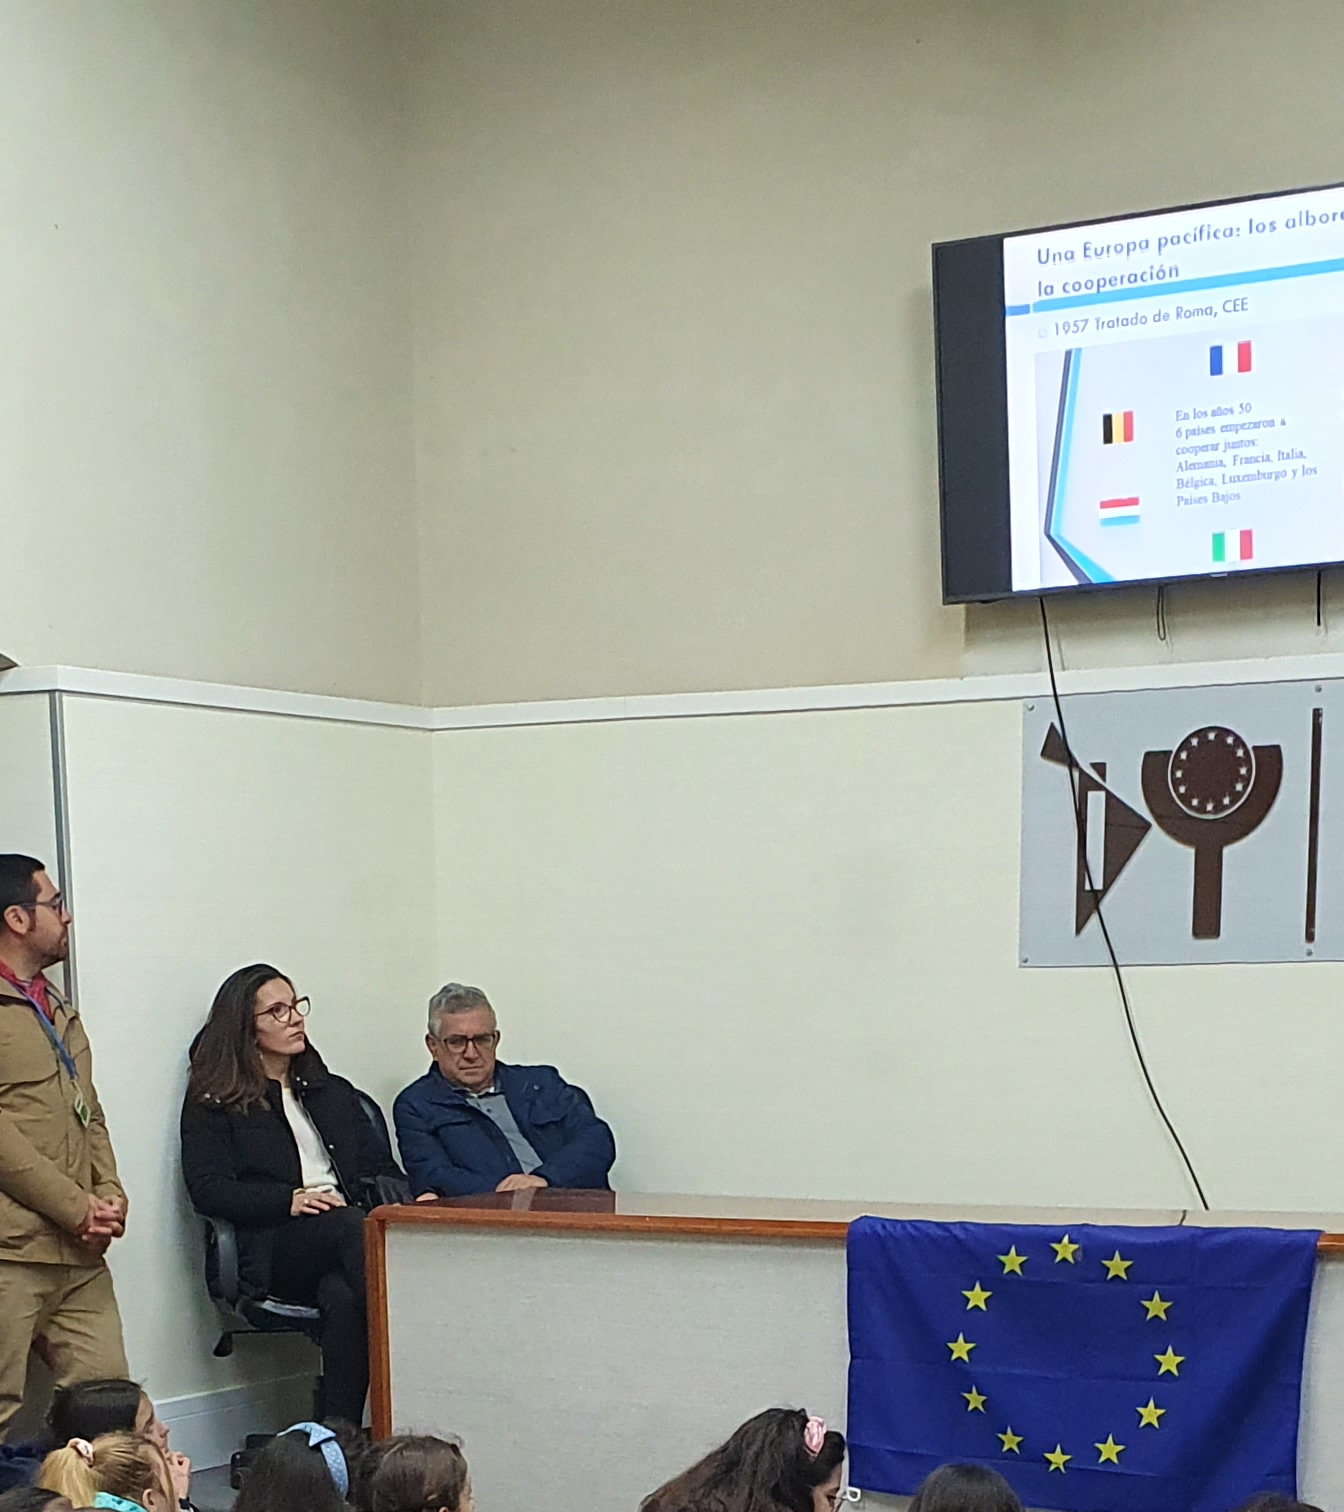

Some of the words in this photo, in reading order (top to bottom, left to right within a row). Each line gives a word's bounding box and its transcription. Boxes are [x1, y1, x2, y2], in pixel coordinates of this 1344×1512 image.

[1037, 247, 1075, 265] Una
[1083, 239, 1150, 259] Europa
[1157, 224, 1241, 255] pacífica:
[1249, 218, 1277, 234] los
[1037, 280, 1055, 297] la
[1062, 264, 1180, 293] cooperación
[1054, 318, 1089, 336] 1957
[1094, 312, 1148, 331] Tratado
[1152, 309, 1170, 323] de
[1175, 304, 1219, 320] Roma,
[1222, 297, 1249, 313] CEE
[1175, 410, 1190, 421] En
[1193, 408, 1208, 419] los
[1238, 402, 1252, 414] 50
[1175, 427, 1183, 438] 6
[1219, 418, 1275, 434] empezaron
[1175, 442, 1220, 456] cooperar
[1222, 469, 1287, 485] Luxemburgo
[1301, 464, 1318, 476] los
[1211, 491, 1241, 504] Bajos
